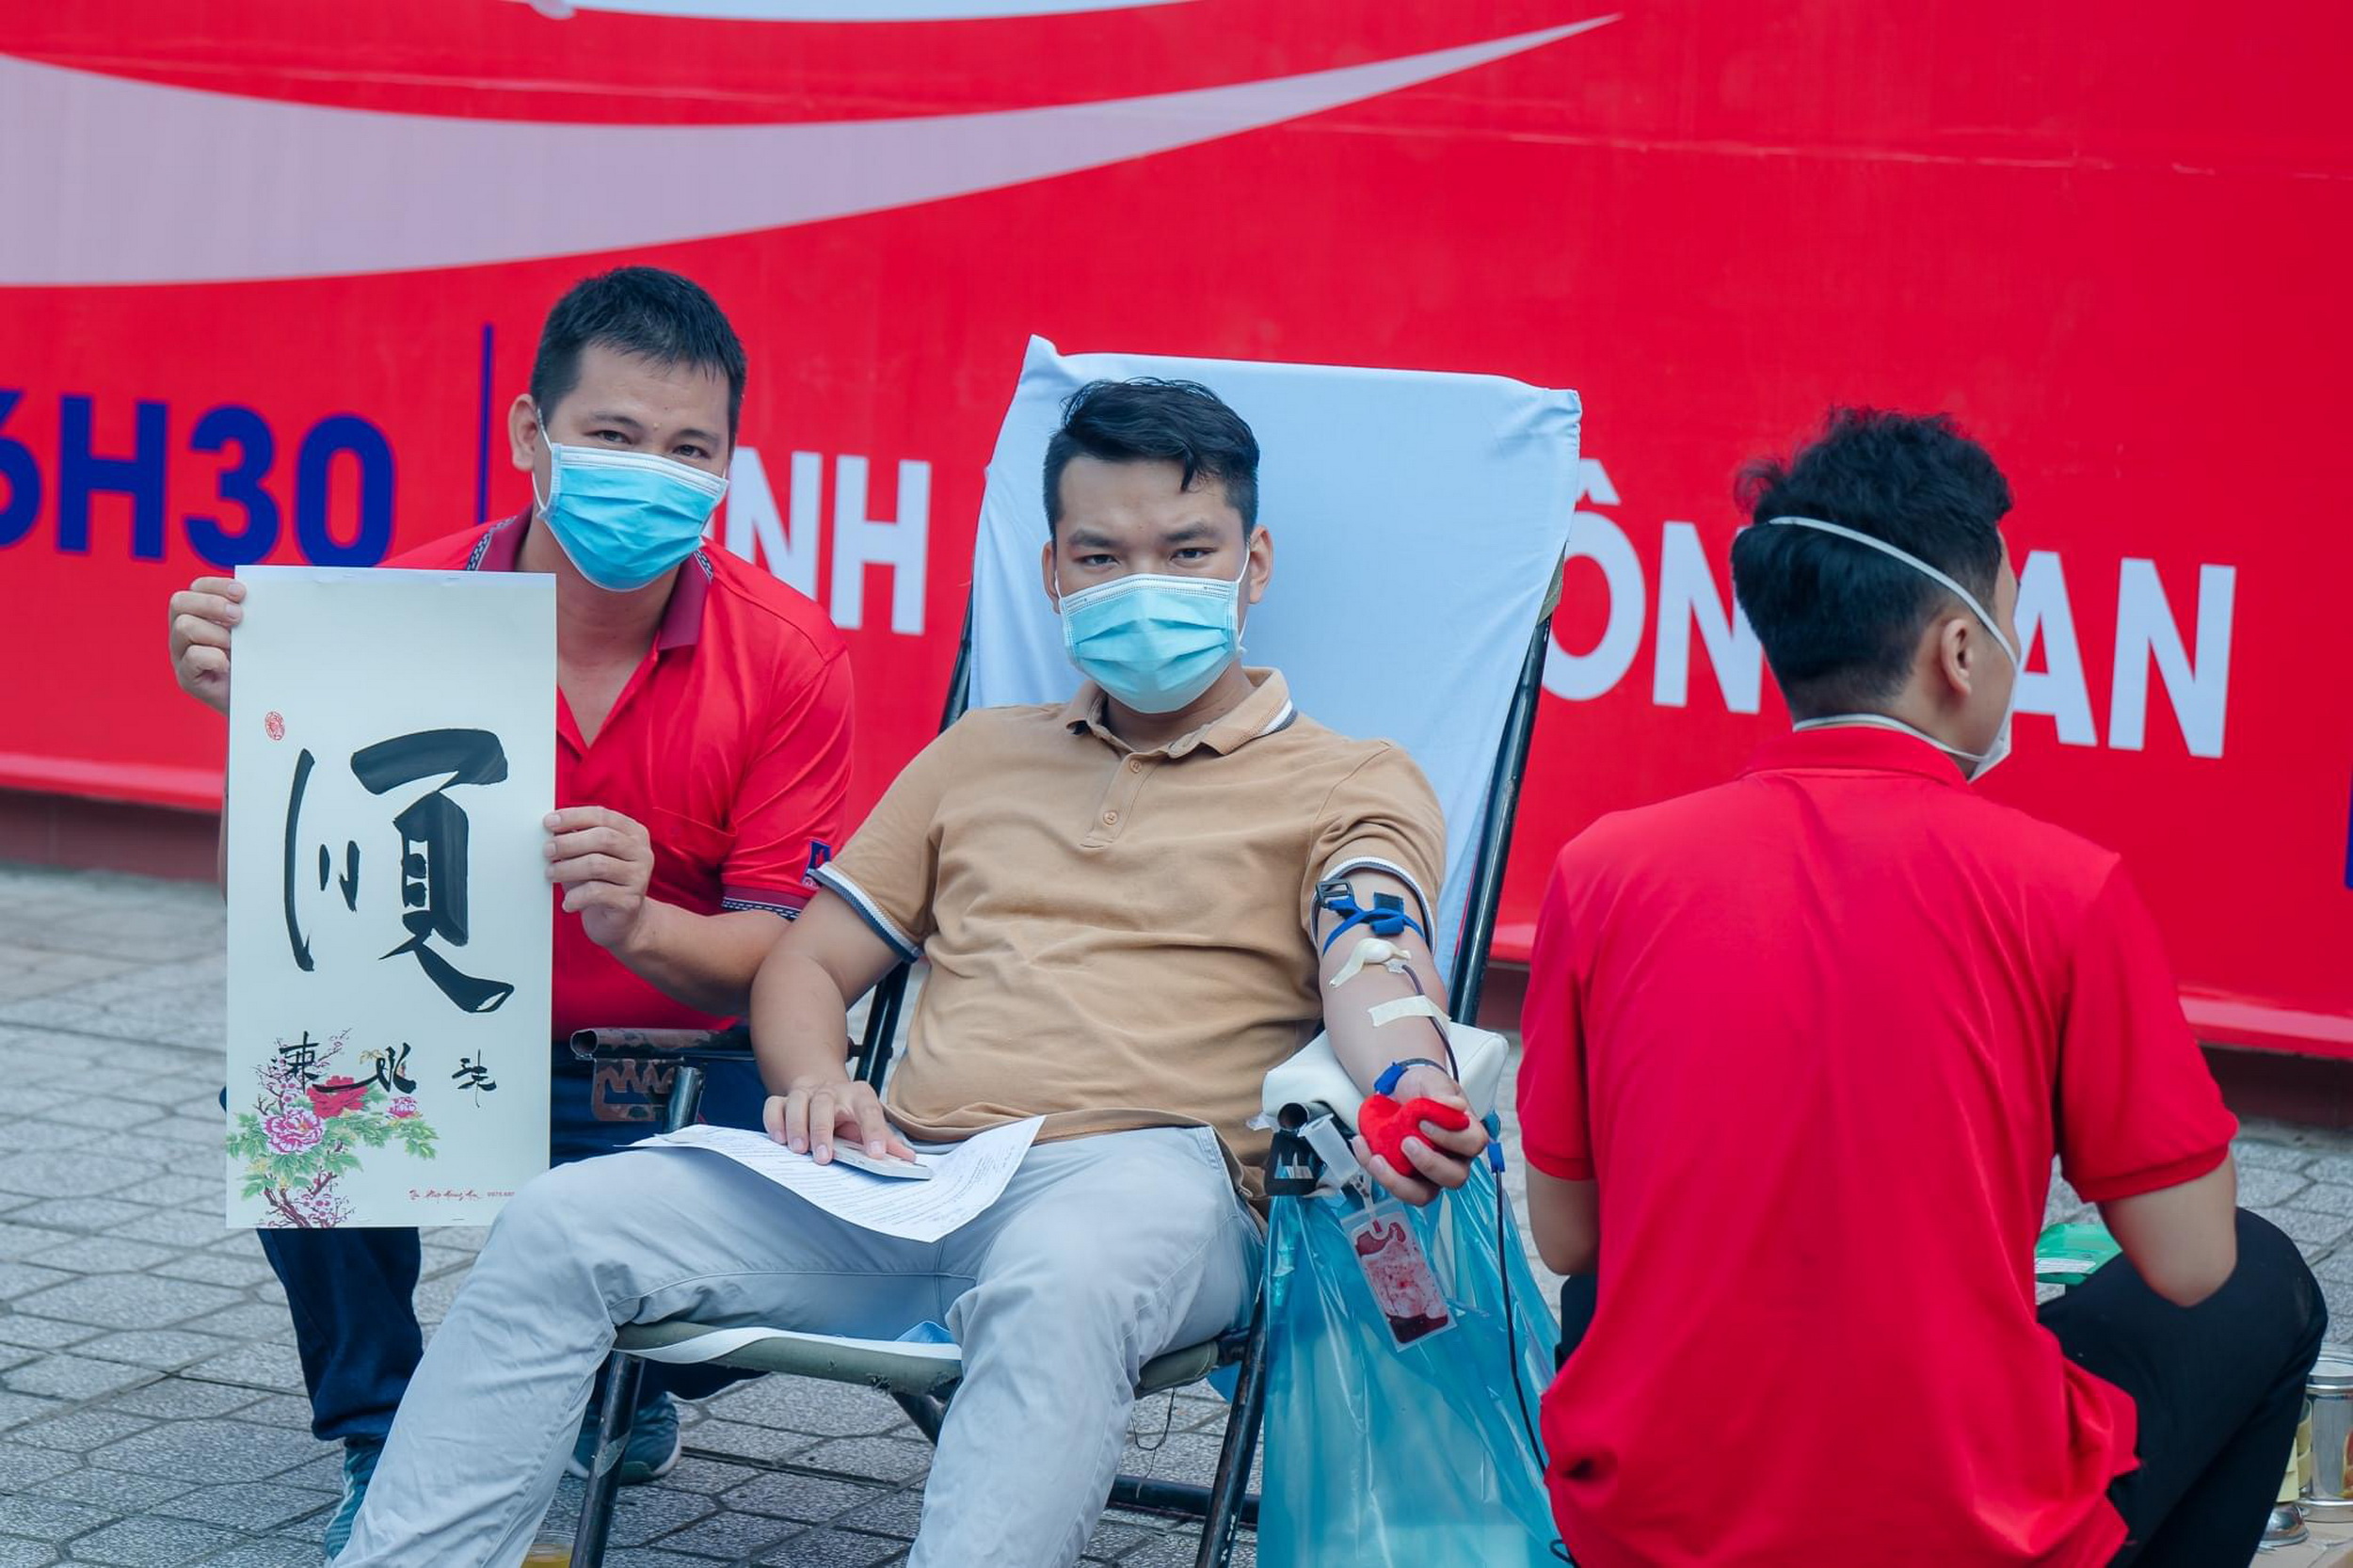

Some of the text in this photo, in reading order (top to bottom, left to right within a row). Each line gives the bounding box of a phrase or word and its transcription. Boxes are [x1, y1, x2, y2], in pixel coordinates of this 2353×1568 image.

[702, 446, 2237, 760] NH ÔN AN
